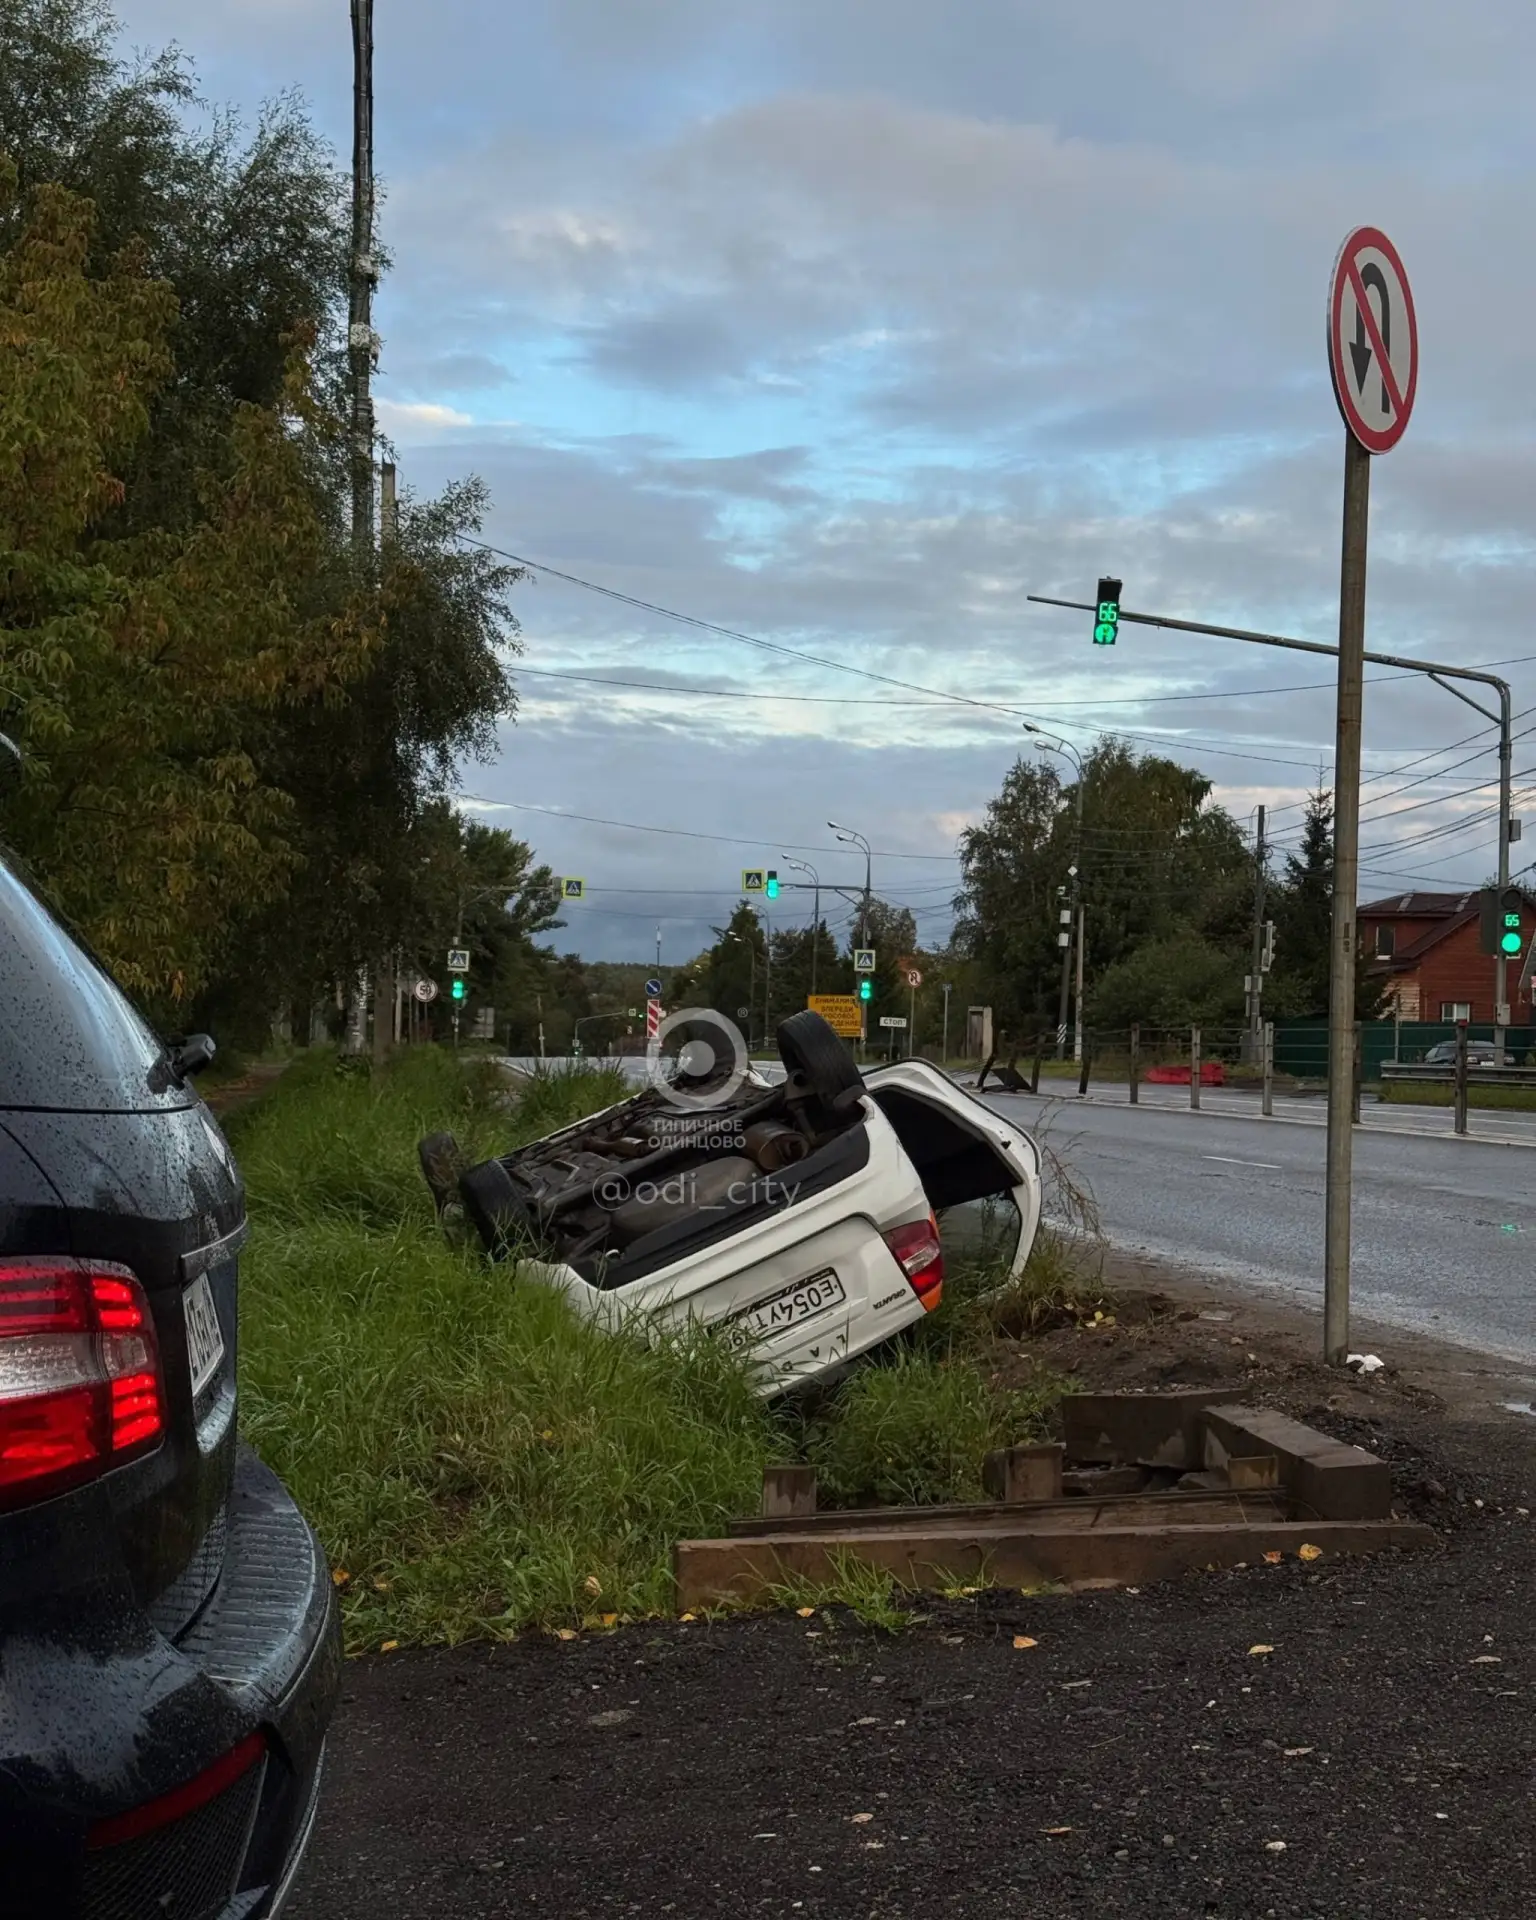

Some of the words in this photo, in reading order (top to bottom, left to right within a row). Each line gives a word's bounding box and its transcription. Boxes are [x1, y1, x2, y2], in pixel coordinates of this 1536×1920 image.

[1505, 914, 1520, 927] 65
[420, 985, 432, 995] 50
[883, 1018, 903, 1026] СТОП
[873, 1288, 907, 1311] GRANTA
